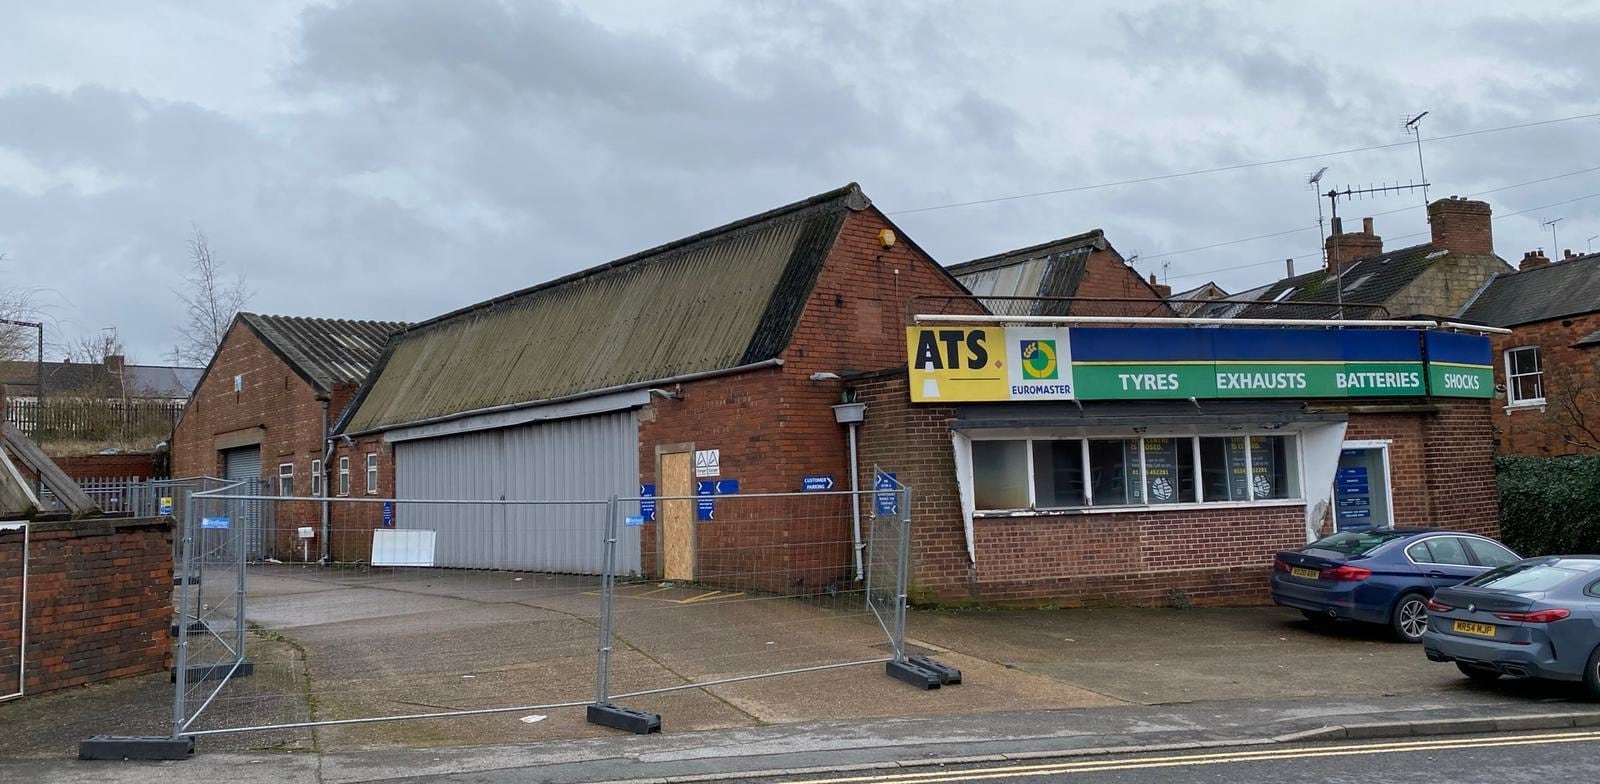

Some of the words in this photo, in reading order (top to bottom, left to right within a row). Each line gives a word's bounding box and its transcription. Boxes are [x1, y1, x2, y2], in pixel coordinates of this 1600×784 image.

[914, 330, 988, 370] ATS
[1118, 373, 1179, 390] TYRES
[1216, 373, 1306, 389] EXHAUSTS
[1336, 372, 1420, 388] BATTERIES
[1444, 373, 1480, 390] SHOCKS
[1012, 384, 1071, 395] EUROMASTER
[1456, 622, 1475, 632] MR54
[1476, 624, 1492, 634] MJP
